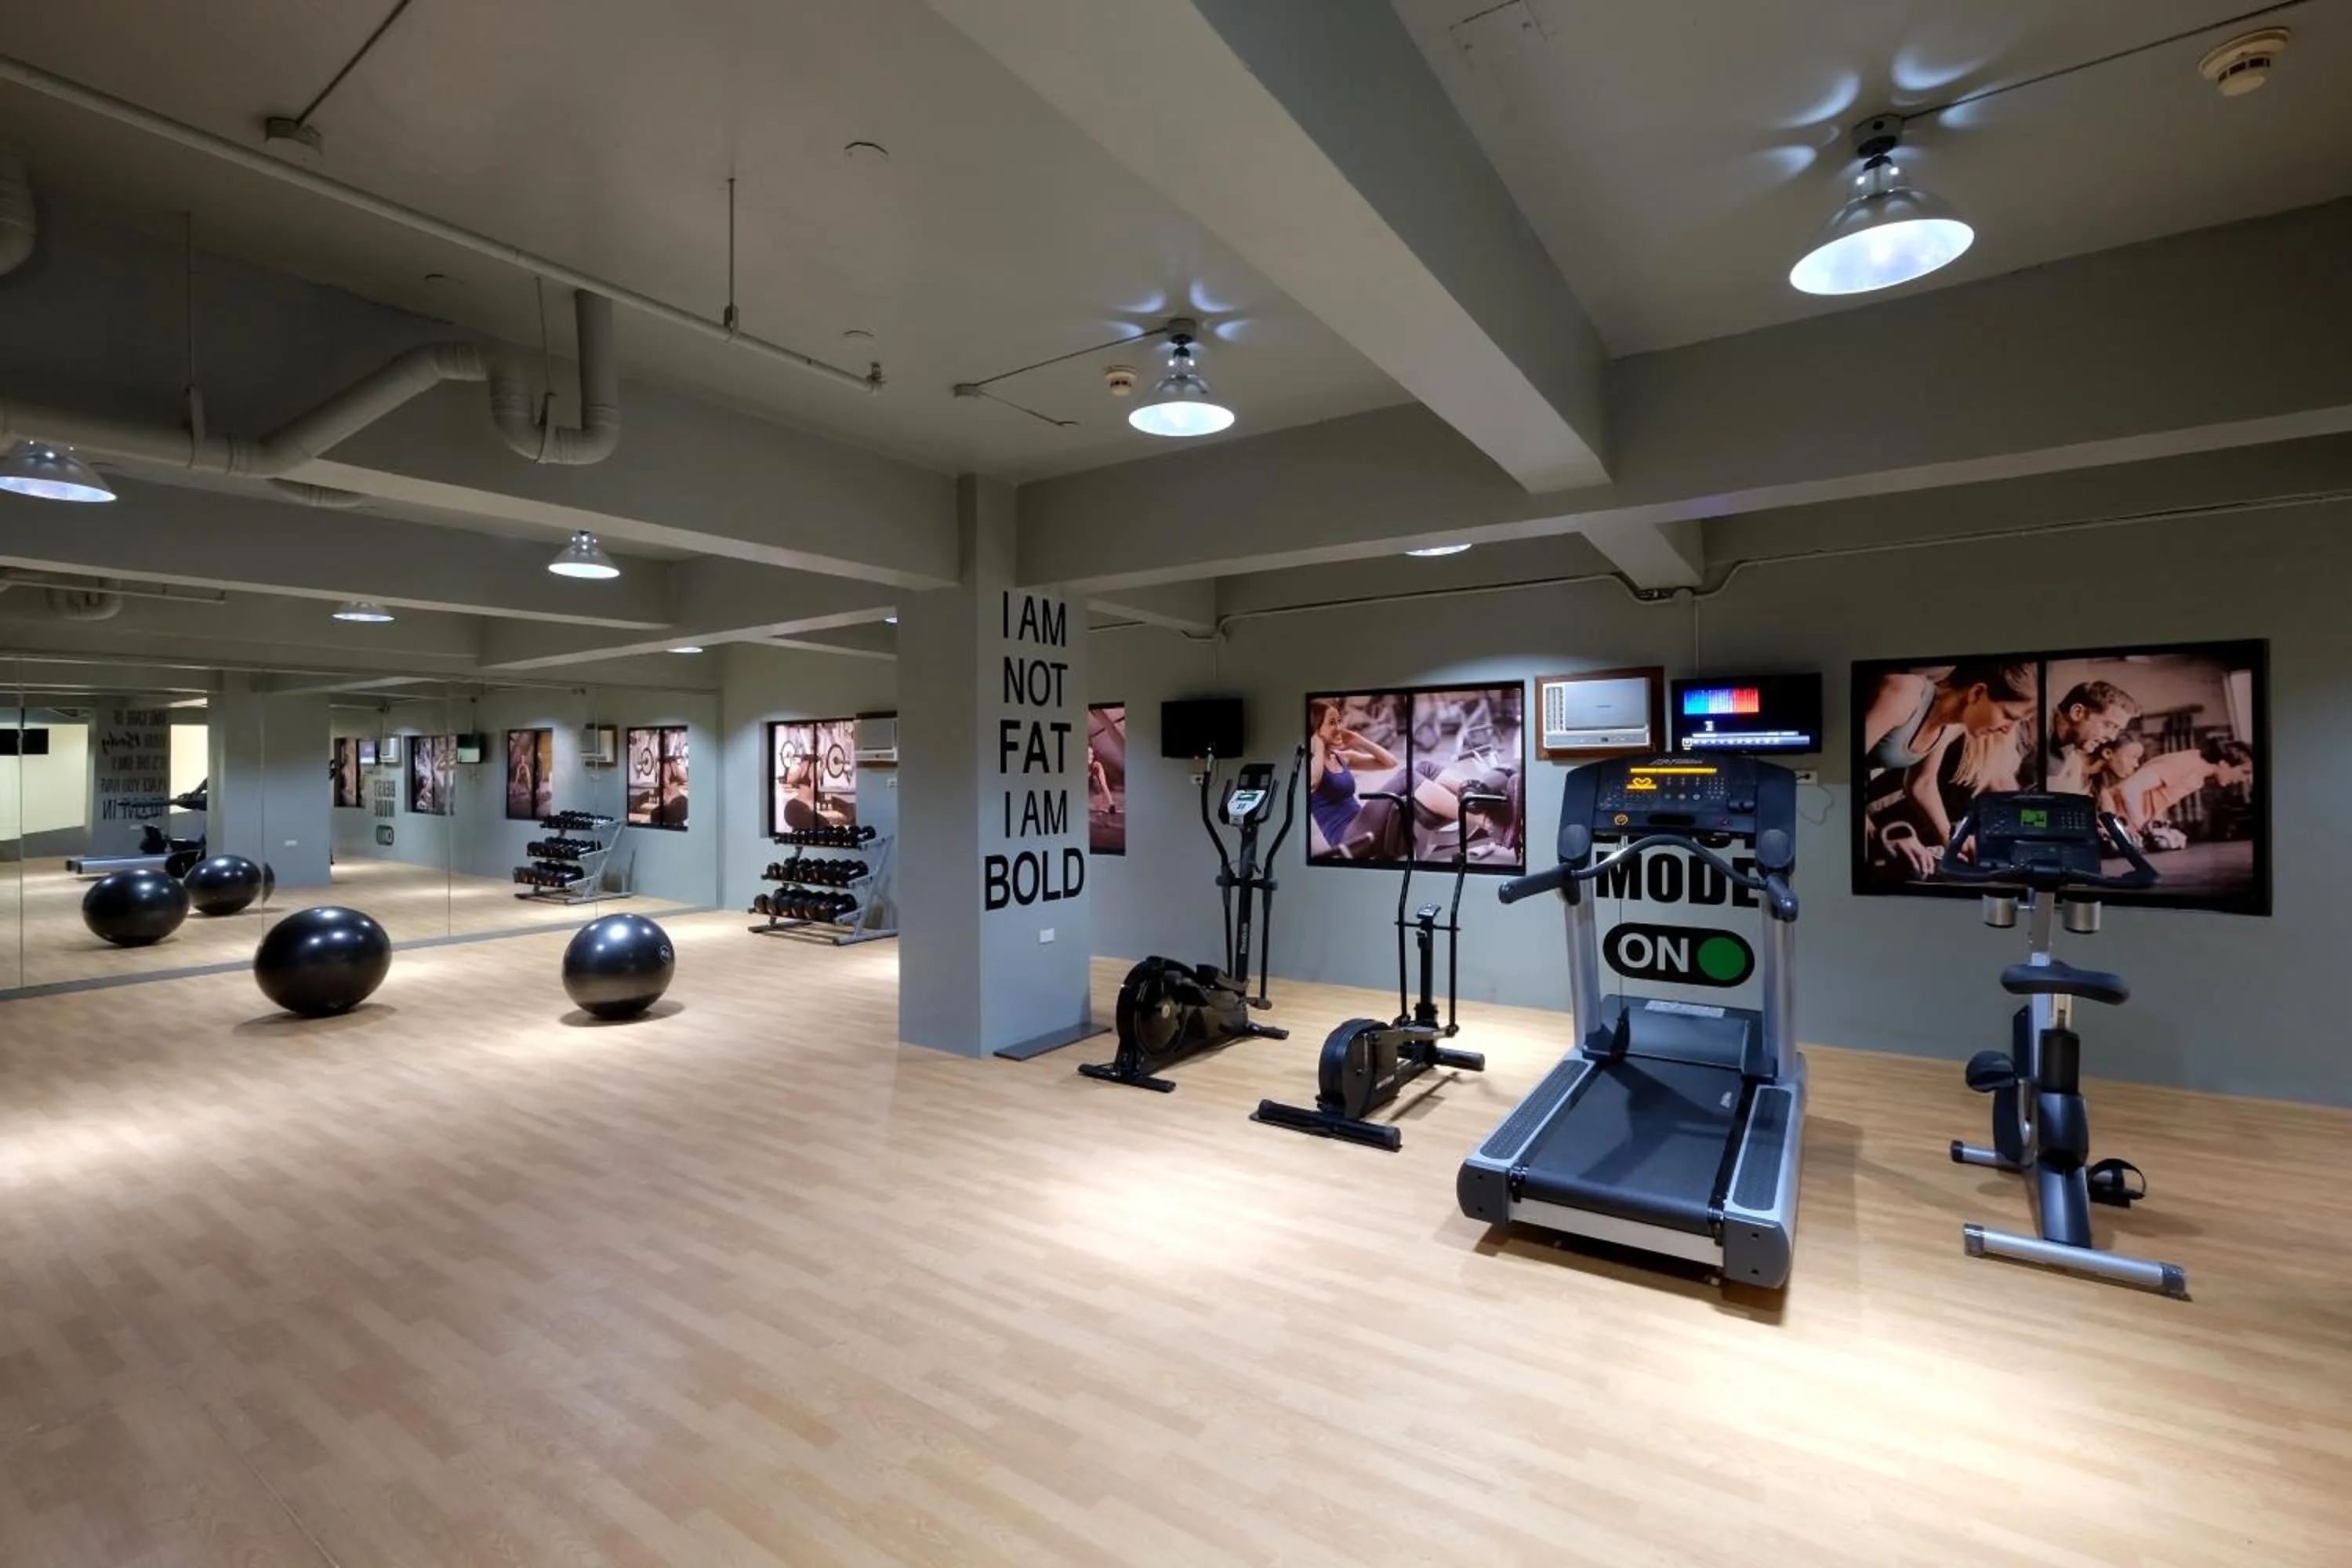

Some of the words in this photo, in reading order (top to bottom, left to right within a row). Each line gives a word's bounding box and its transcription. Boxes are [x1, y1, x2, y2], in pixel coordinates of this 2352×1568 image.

[1002, 590, 1009, 639] I
[1018, 595, 1067, 648] AM
[1003, 656, 1068, 708] NOT
[1000, 719, 1071, 775] FAT
[1004, 790, 1011, 839] I
[1020, 789, 1068, 837] AM
[985, 848, 1085, 911] BOLD
[1595, 851, 1759, 908] MODE
[1617, 932, 1690, 973] ON
